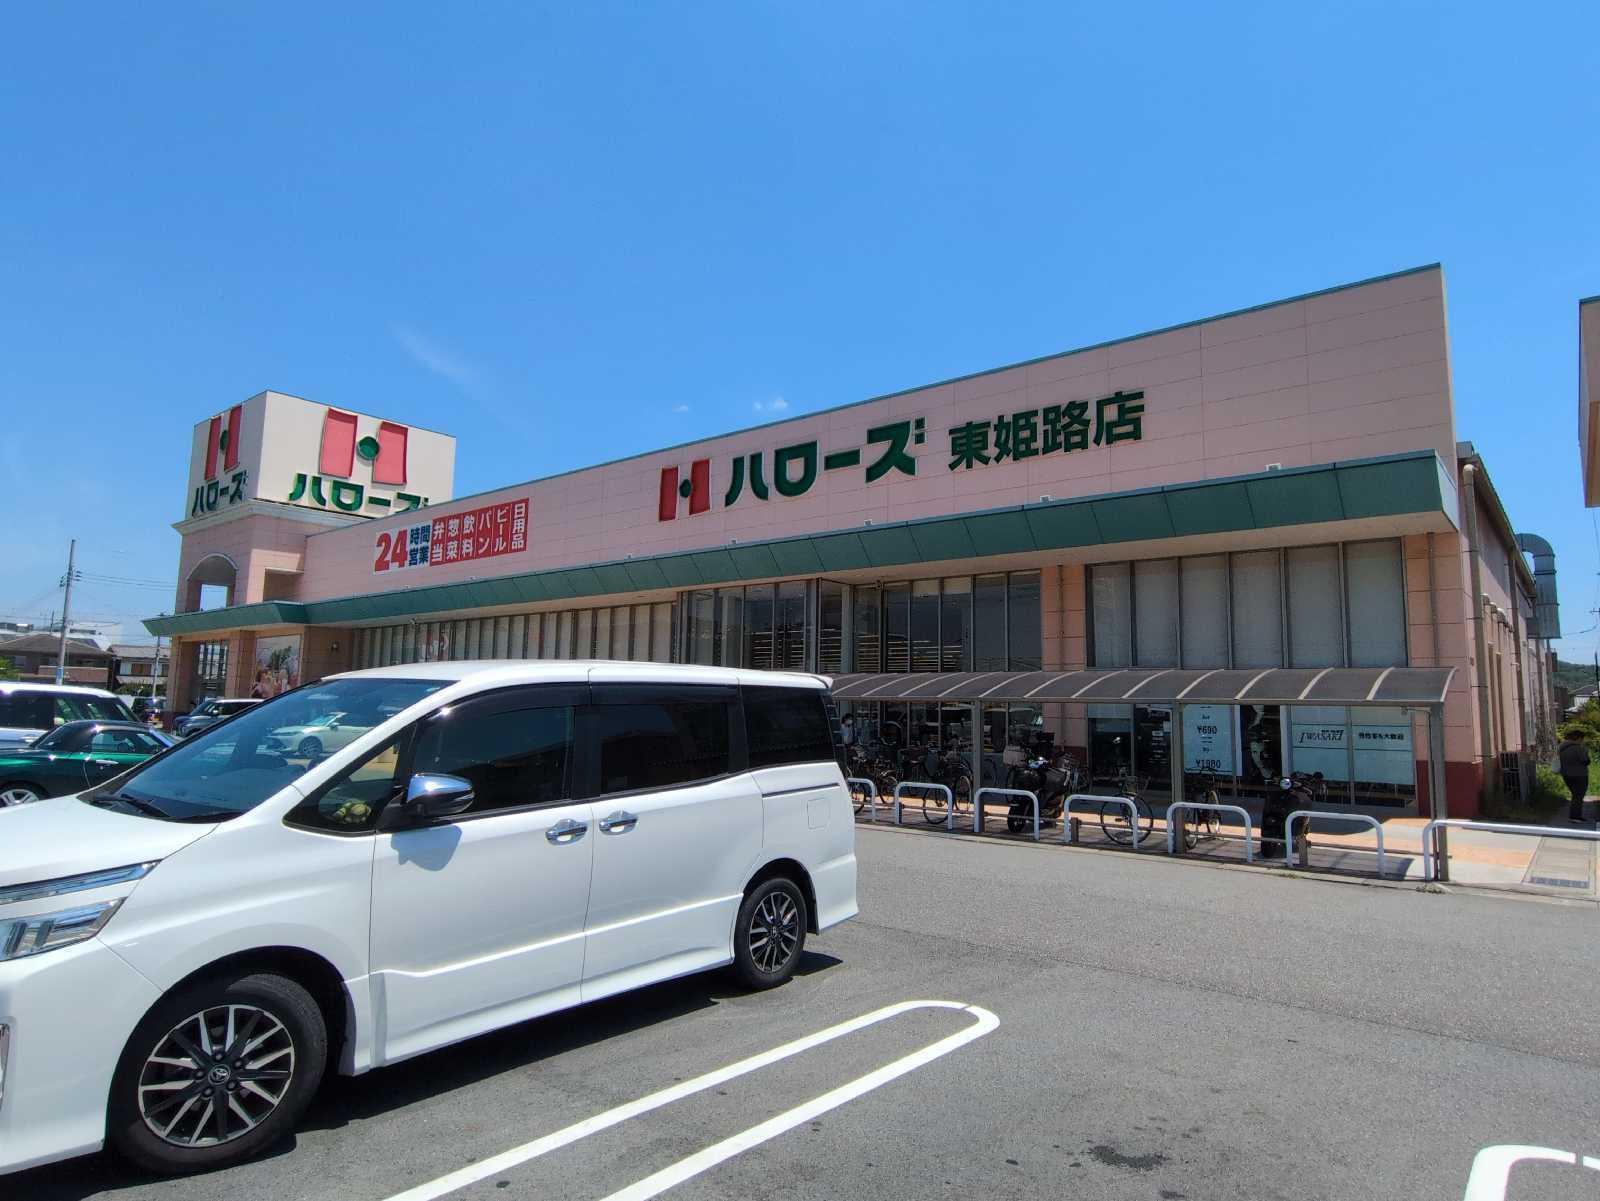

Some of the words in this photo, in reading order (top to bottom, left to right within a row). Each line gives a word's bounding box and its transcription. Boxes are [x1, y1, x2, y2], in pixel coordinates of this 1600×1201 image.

[725, 417, 926, 508] ハローズ
[948, 391, 1146, 471] 東姫路店
[191, 470, 248, 517] ハローズ
[410, 524, 431, 545] 時間
[431, 521, 445, 562] 弁当
[462, 515, 475, 557] 飲料
[478, 510, 492, 554] パン
[494, 506, 509, 551] ビール
[511, 503, 526, 549] 日用品
[374, 528, 408, 572] 24
